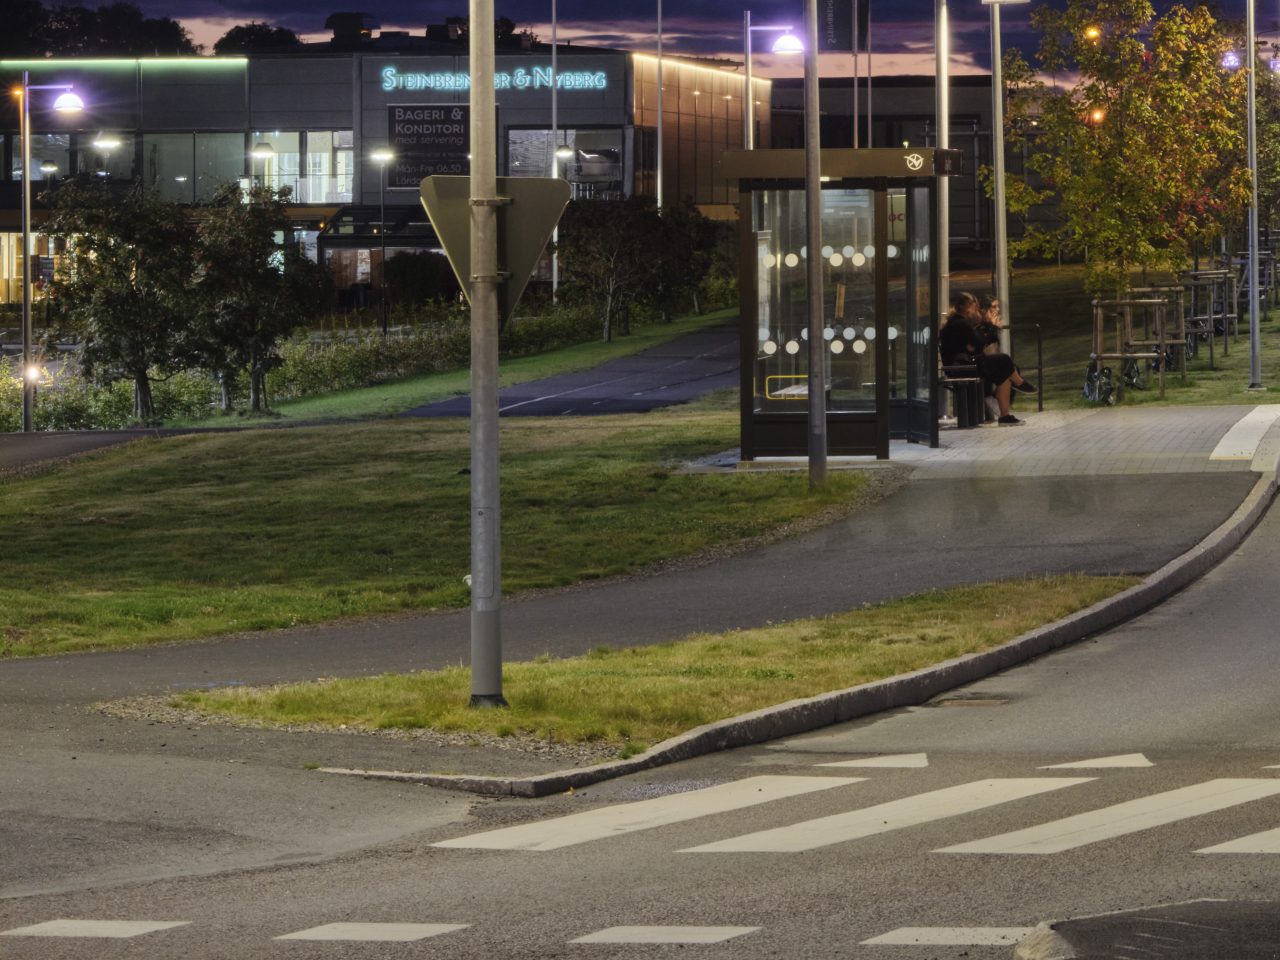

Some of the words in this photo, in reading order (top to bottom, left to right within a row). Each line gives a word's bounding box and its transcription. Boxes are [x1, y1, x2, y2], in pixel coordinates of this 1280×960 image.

[382, 66, 510, 90] STEINBRENER
[513, 68, 531, 89] &
[395, 107, 444, 120] BAGERI
[451, 107, 464, 120] &
[395, 123, 464, 134] KONDITORI
